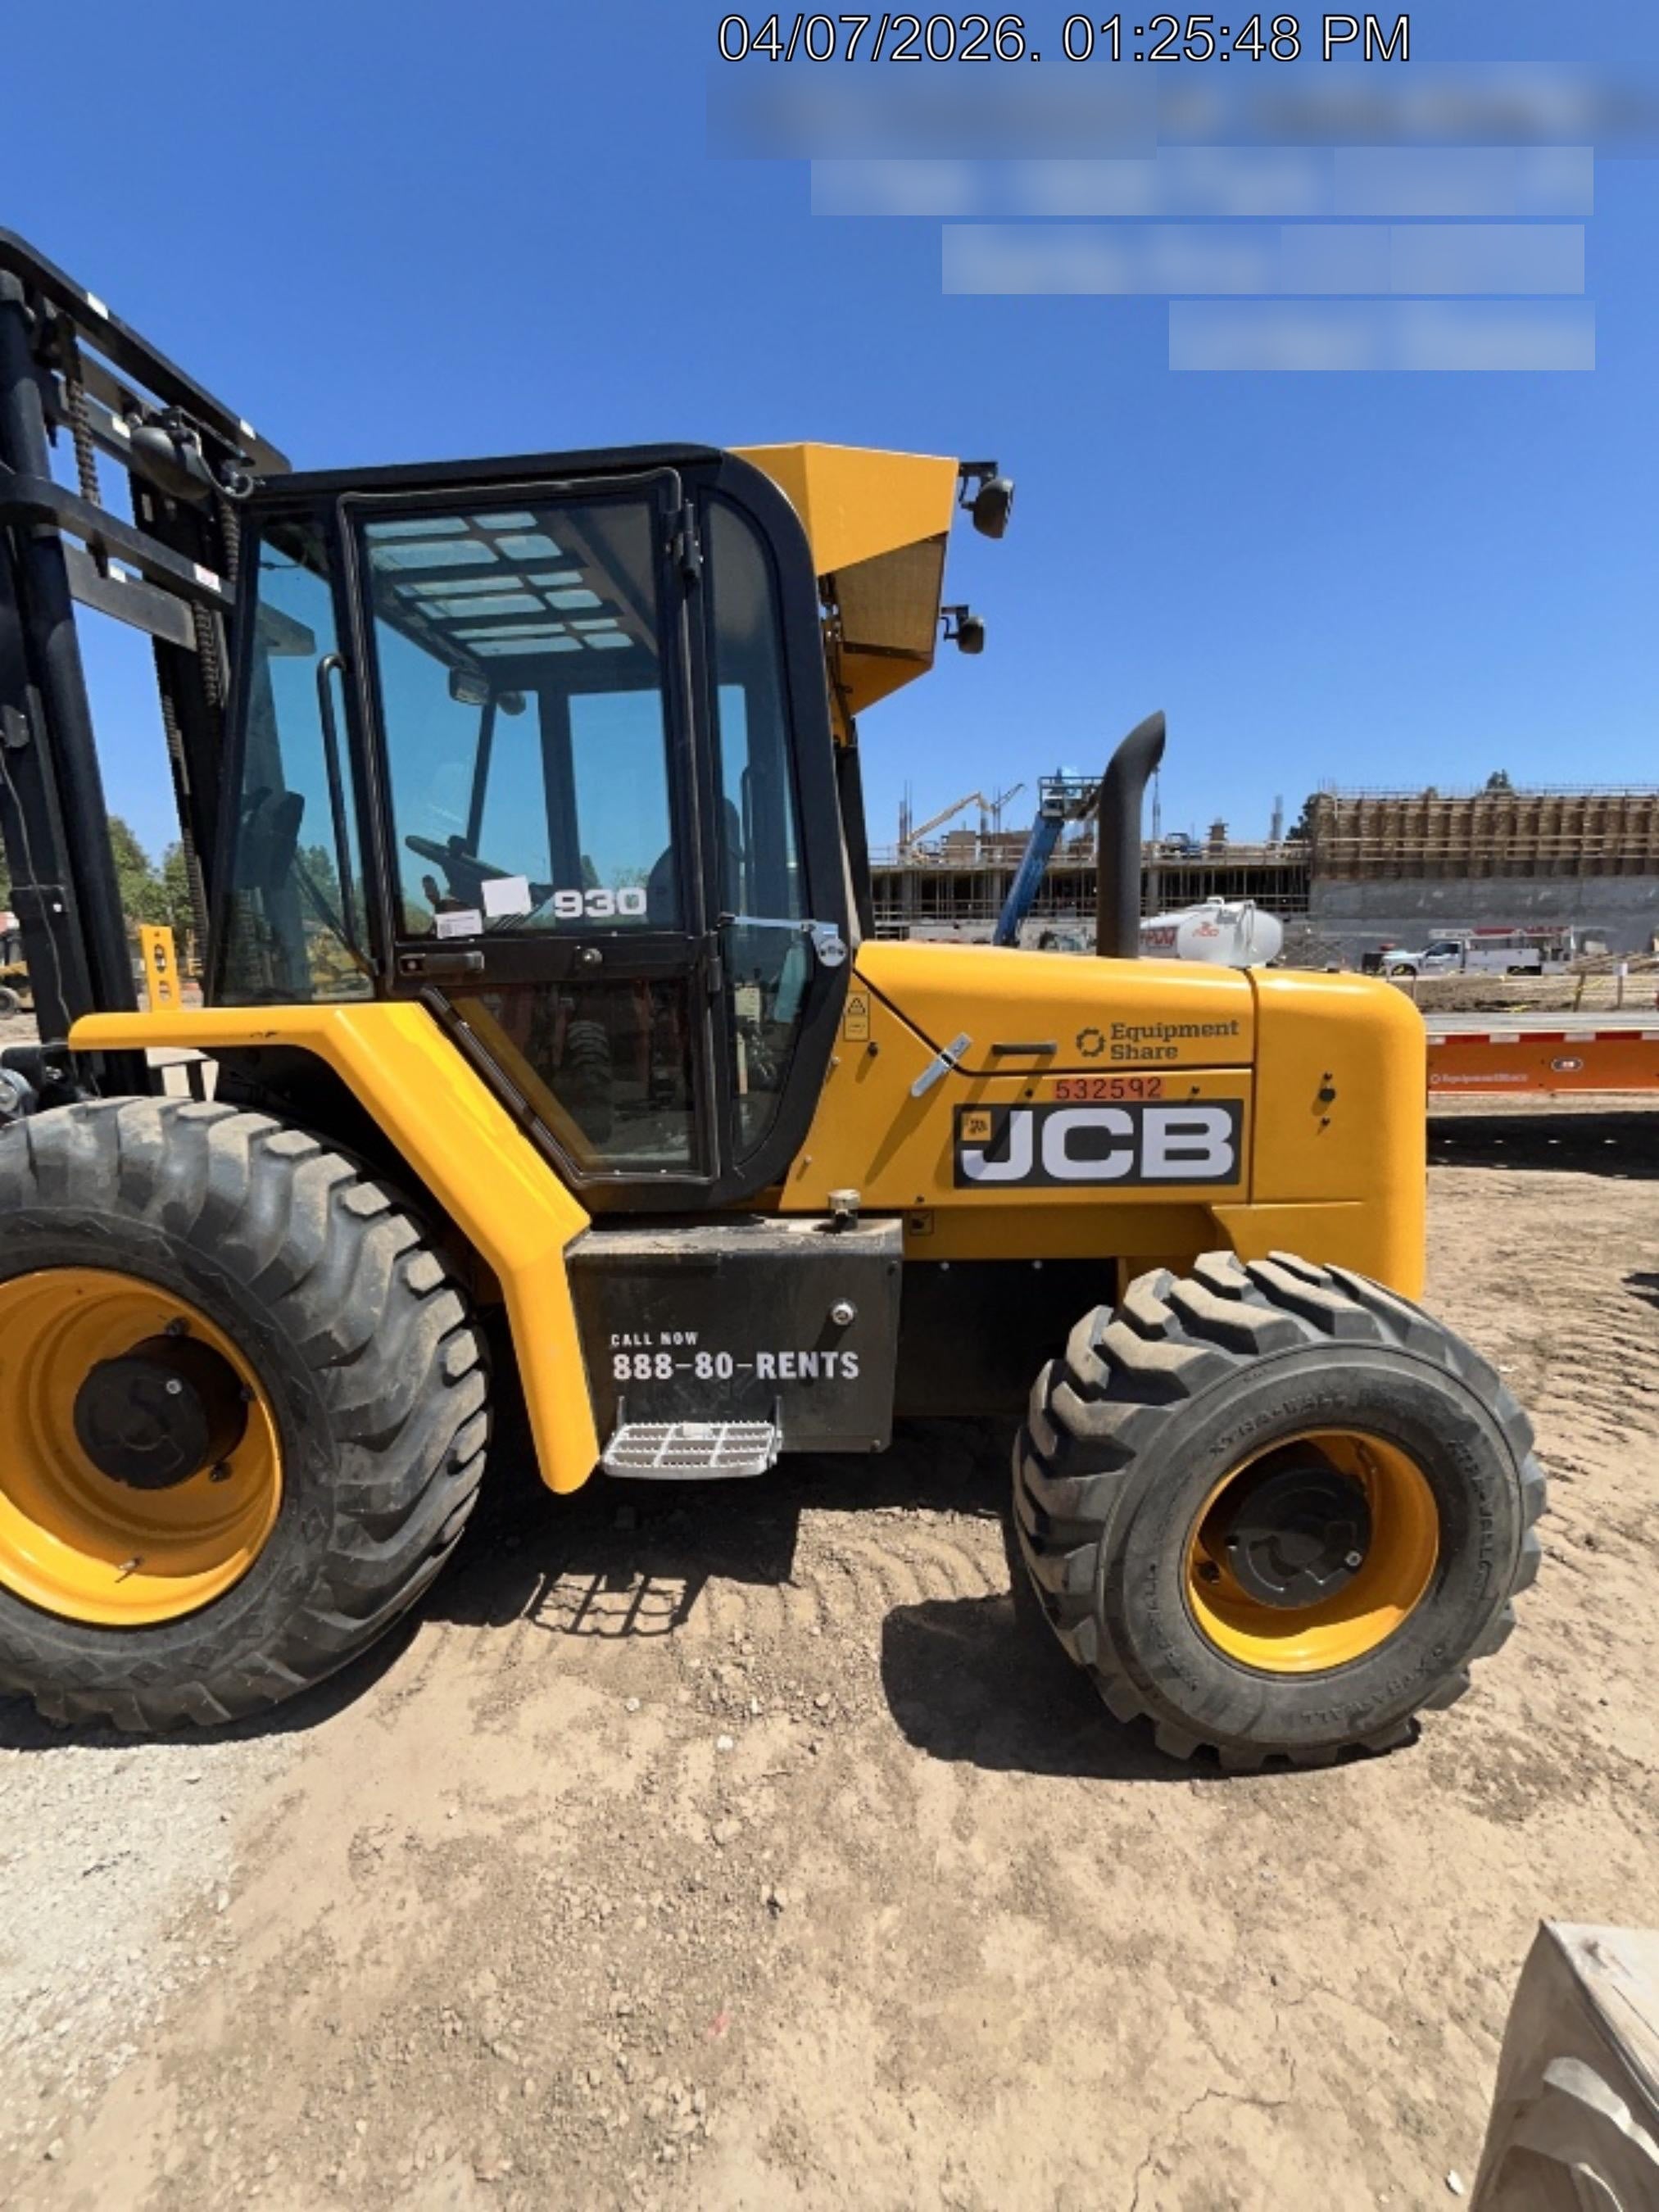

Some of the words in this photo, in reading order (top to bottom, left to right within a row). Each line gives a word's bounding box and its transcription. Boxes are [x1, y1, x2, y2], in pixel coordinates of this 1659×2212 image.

[555, 887, 646, 918] 930
[1110, 1020, 1240, 1043] Equipment
[1110, 1044, 1179, 1061] Share
[1055, 1076, 1162, 1100] 532592
[961, 1107, 1234, 1181] JCB
[611, 1333, 654, 1347] CALL
[660, 1331, 699, 1345] NOW
[613, 1351, 860, 1380] 888-80-RENTS
